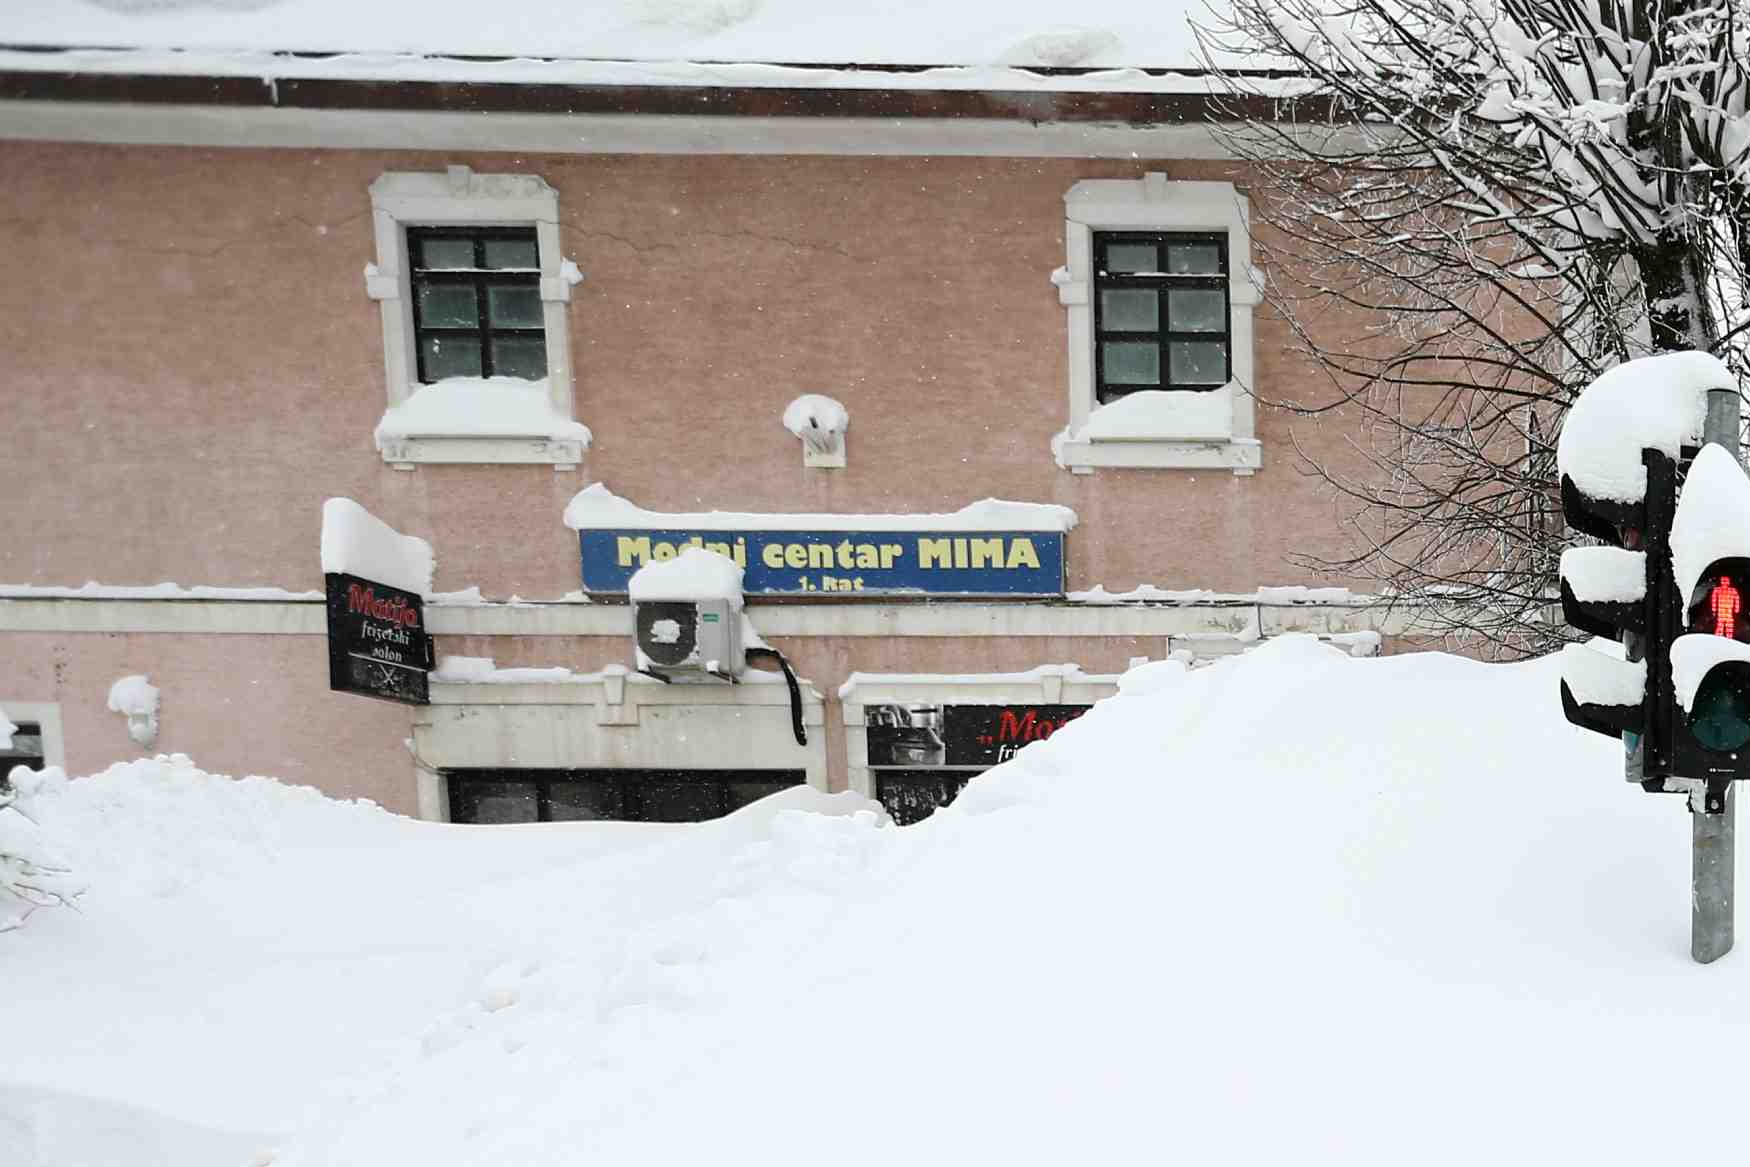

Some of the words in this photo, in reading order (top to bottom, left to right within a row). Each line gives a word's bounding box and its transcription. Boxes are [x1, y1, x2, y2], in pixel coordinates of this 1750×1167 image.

[762, 540, 903, 569] centar
[918, 538, 1040, 568] MIMA
[372, 646, 402, 662] salon
